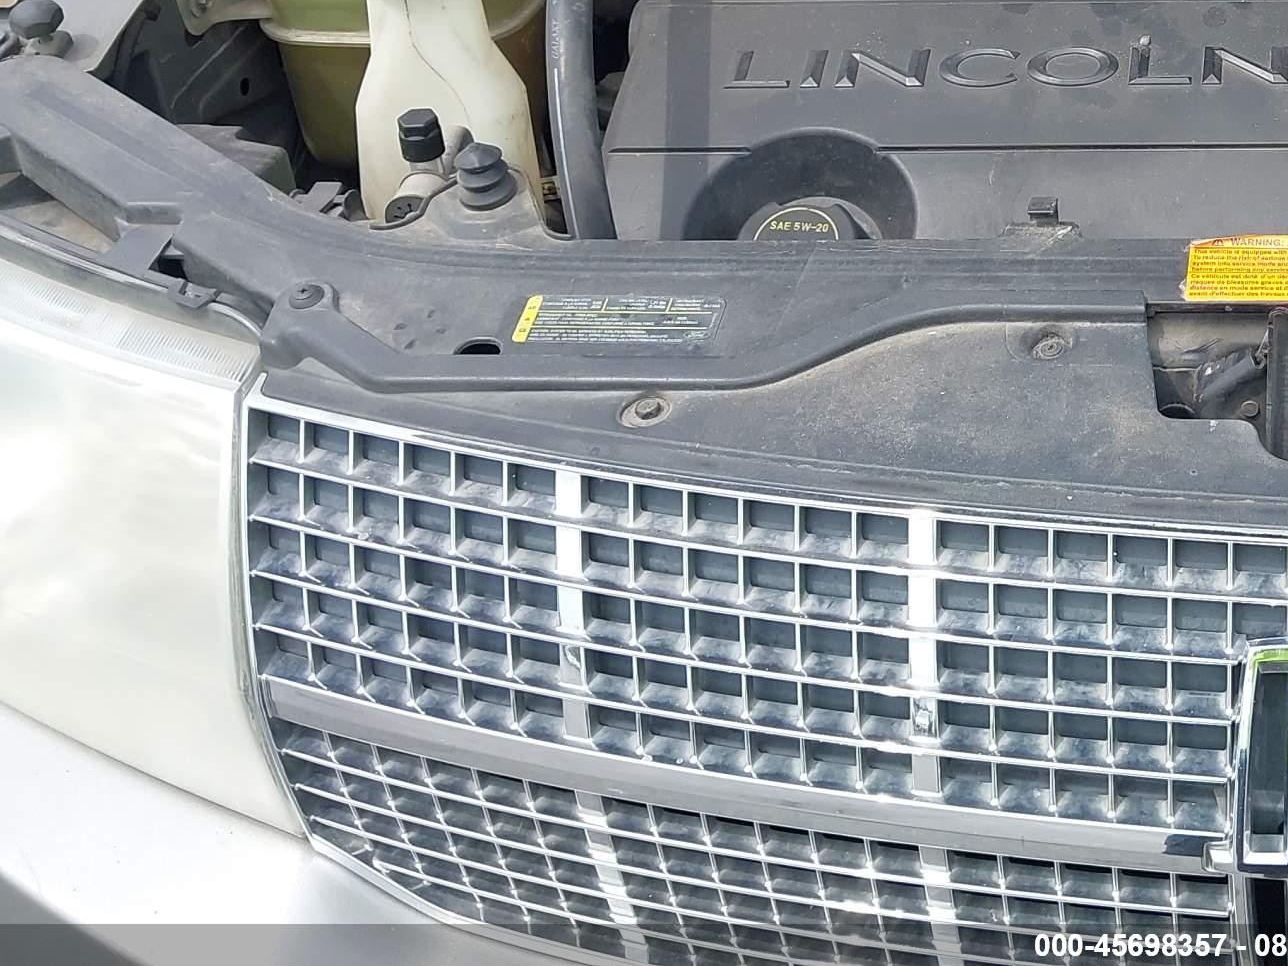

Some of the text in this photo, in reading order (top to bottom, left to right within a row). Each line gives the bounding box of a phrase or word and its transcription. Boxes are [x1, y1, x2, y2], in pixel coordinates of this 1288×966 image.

[770, 221, 830, 233] SAE 5W-20
[1231, 238, 1284, 247] WARNING:
